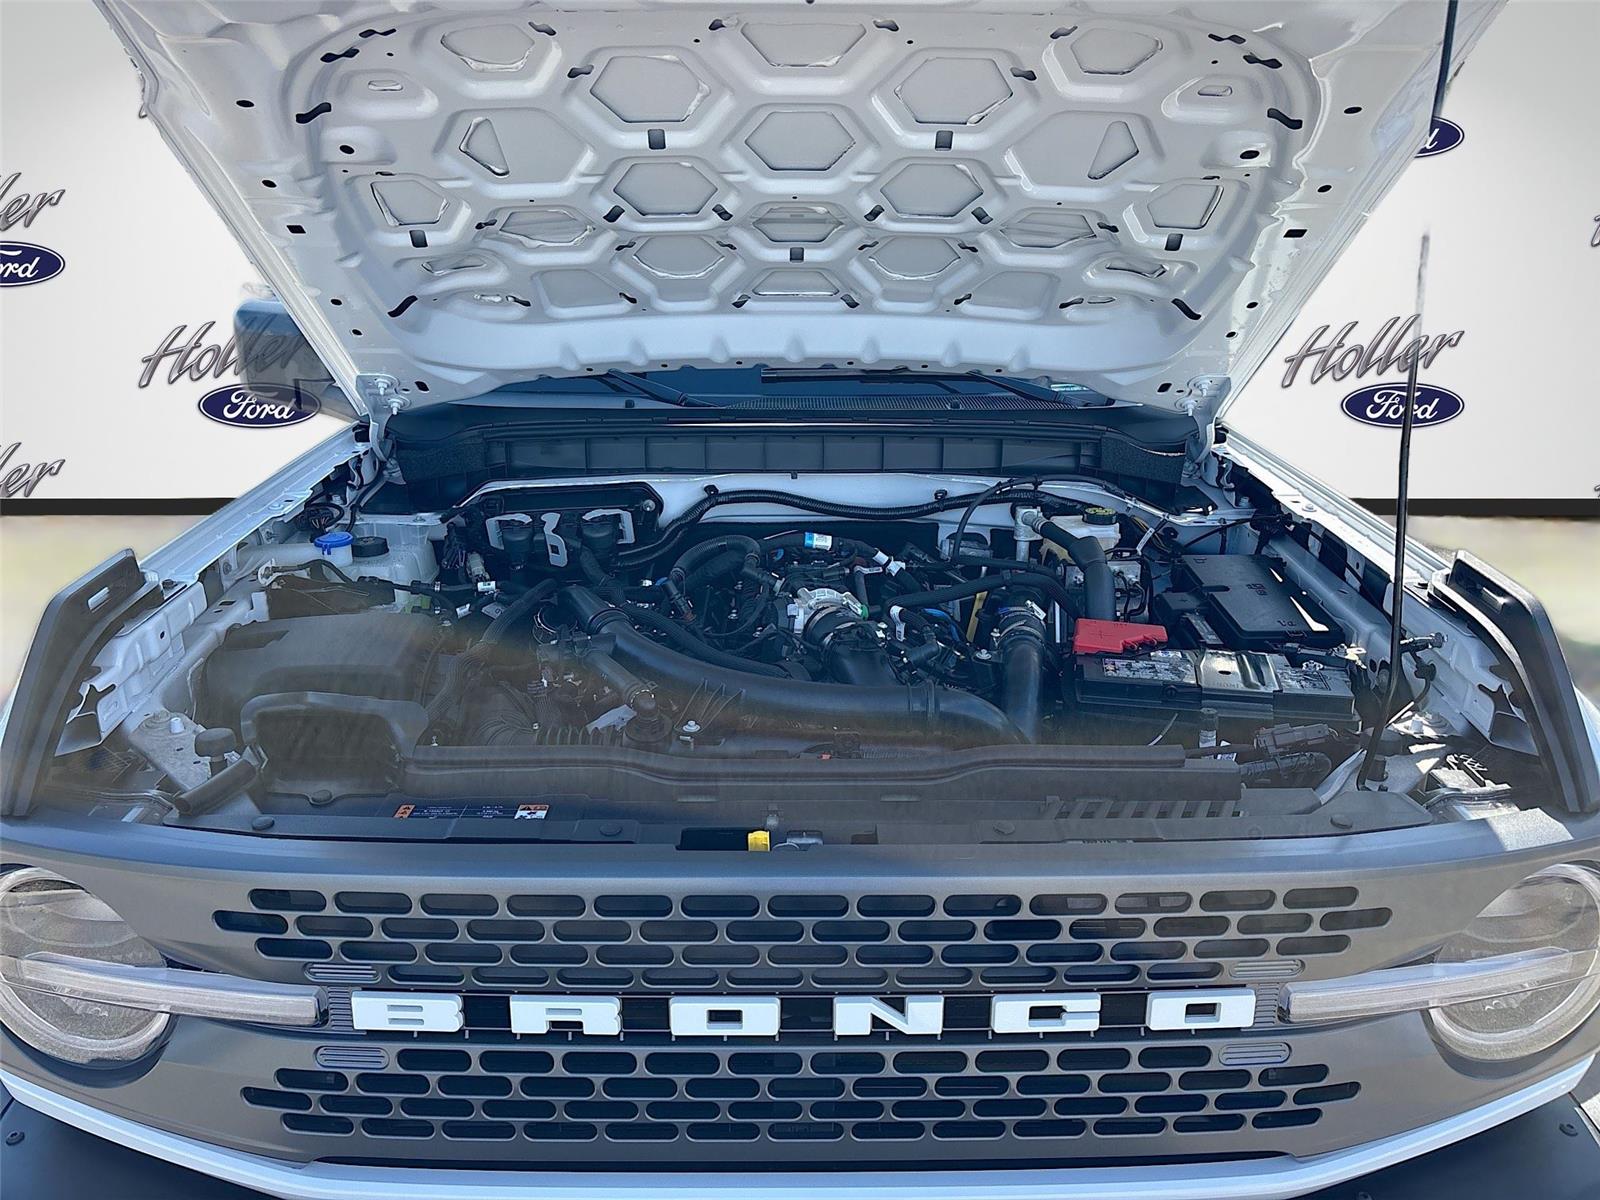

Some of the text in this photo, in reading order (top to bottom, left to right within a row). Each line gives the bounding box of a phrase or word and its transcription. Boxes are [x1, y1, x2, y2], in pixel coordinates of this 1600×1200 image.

[1280, 313, 1465, 389] Holler
[223, 389, 296, 420] Ford
[351, 987, 1256, 1037] BRONCO
